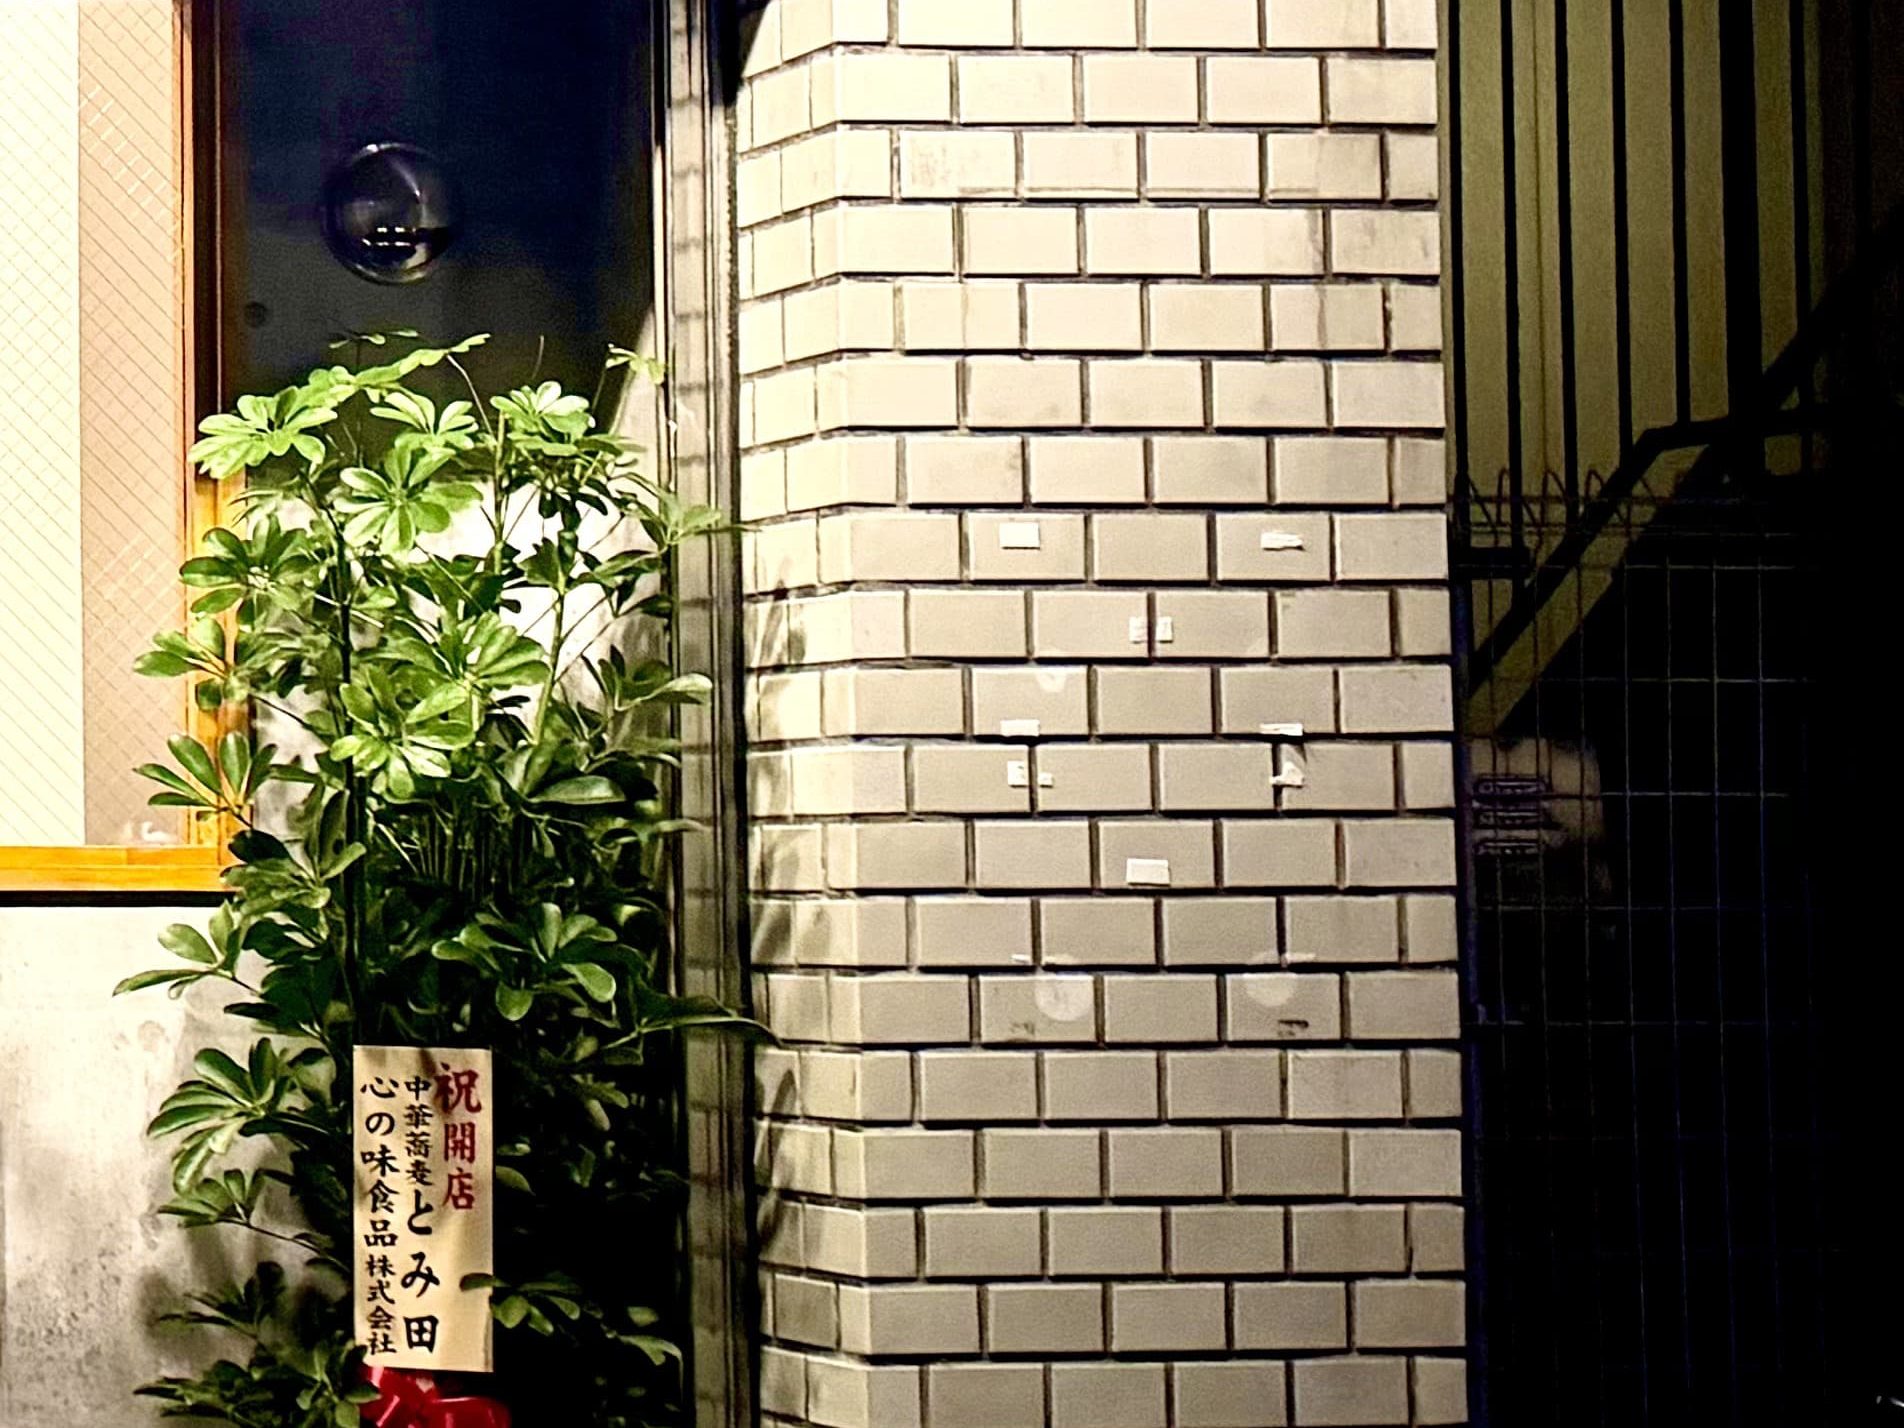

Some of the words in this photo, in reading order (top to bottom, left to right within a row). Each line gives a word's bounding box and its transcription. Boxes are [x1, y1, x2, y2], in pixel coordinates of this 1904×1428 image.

[360, 1075, 400, 1356] 心の味食品株式会社
[401, 1075, 440, 1353] 中華蕎麦とみ田
[434, 1062, 482, 1211] 祝開店
